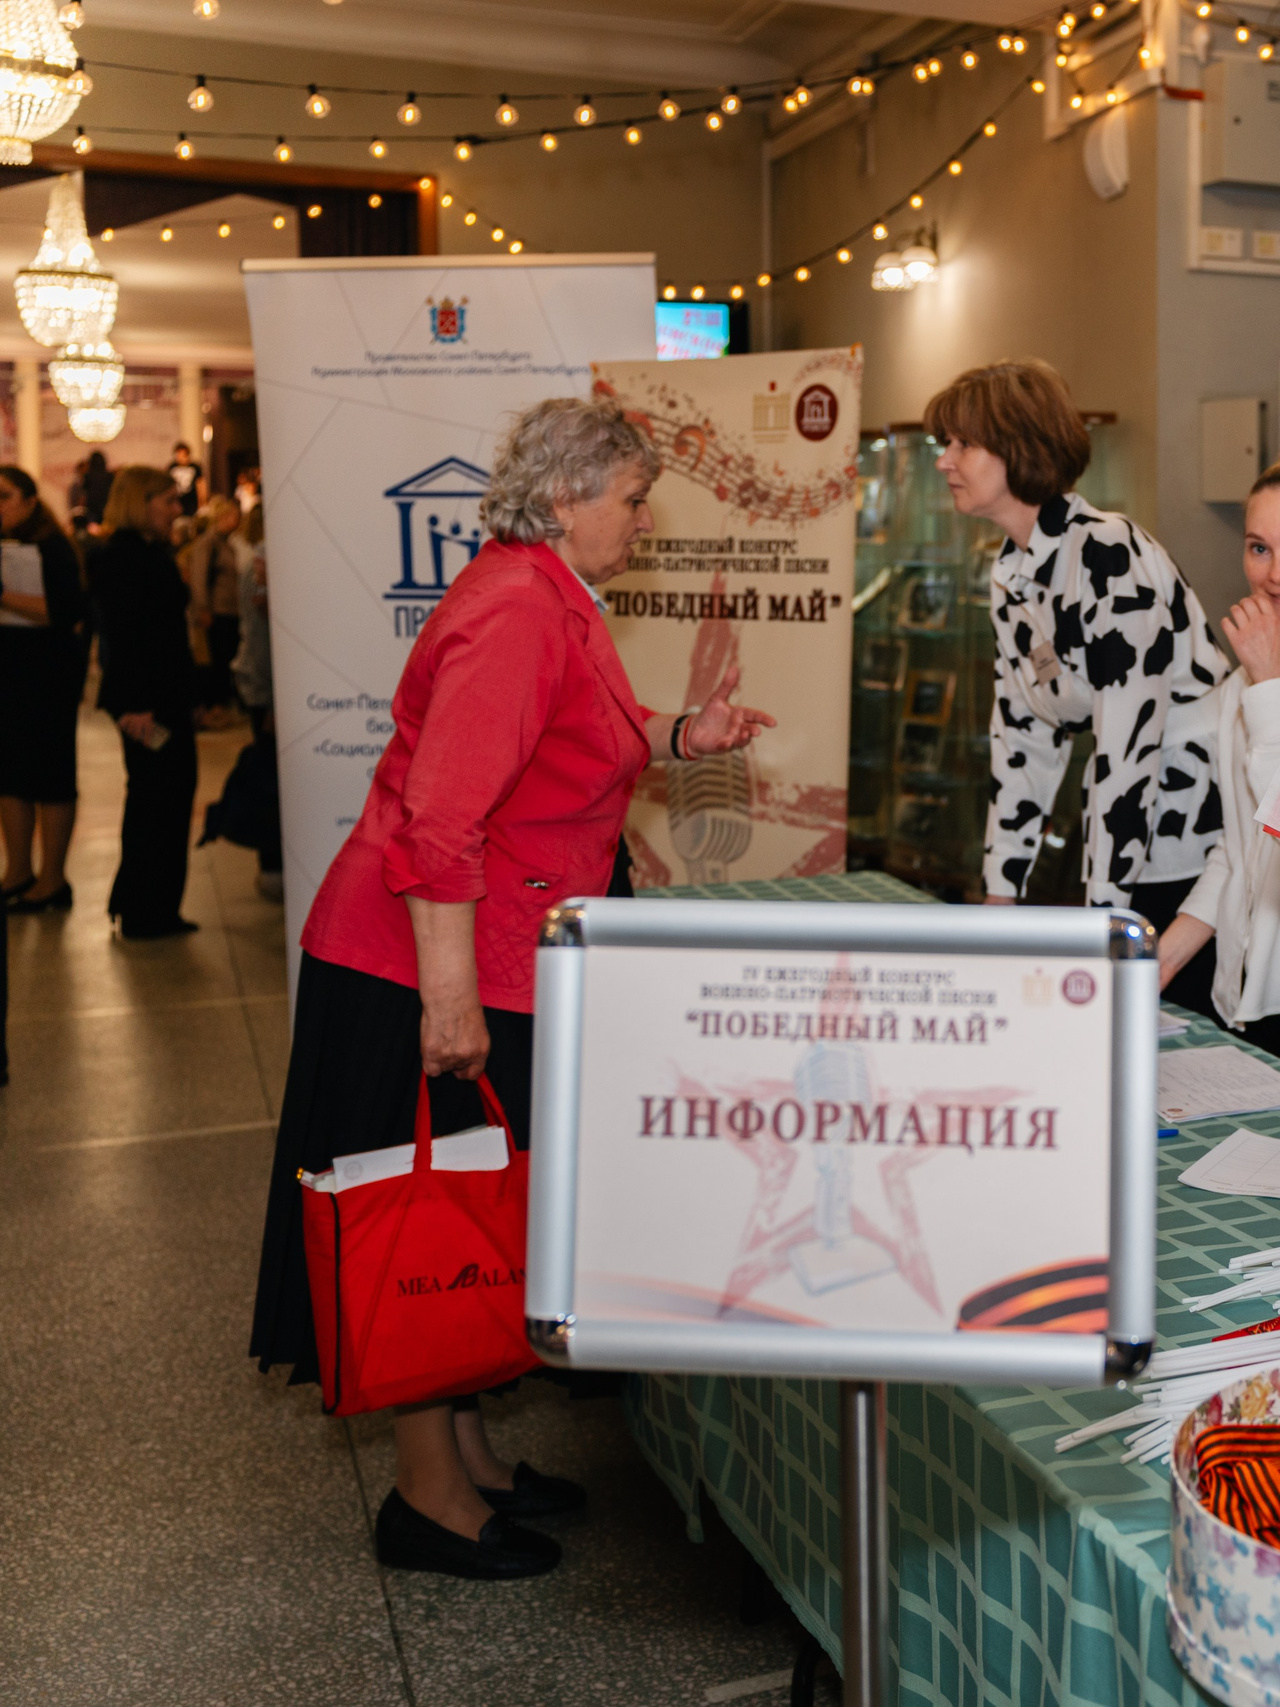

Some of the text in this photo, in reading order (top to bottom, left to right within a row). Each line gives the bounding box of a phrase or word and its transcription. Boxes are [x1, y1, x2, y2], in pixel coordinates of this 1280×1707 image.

[656, 536, 735, 554] ЕЖЕГОДНЫЙ
[739, 538, 797, 555] КОНКУРС
[784, 558, 829, 573] ПЕСНИ
[742, 966, 956, 985] IV ЕЖЕГОДНЫЙ КОНКУРС
[700, 983, 997, 1006] ВОЕННО-ПАТРИОТИЧЕСКОЙ ПЕСНИ
[637, 1095, 1061, 1156] ИНФОРМАЦИЯ
[397, 1276, 442, 1298] MEA
